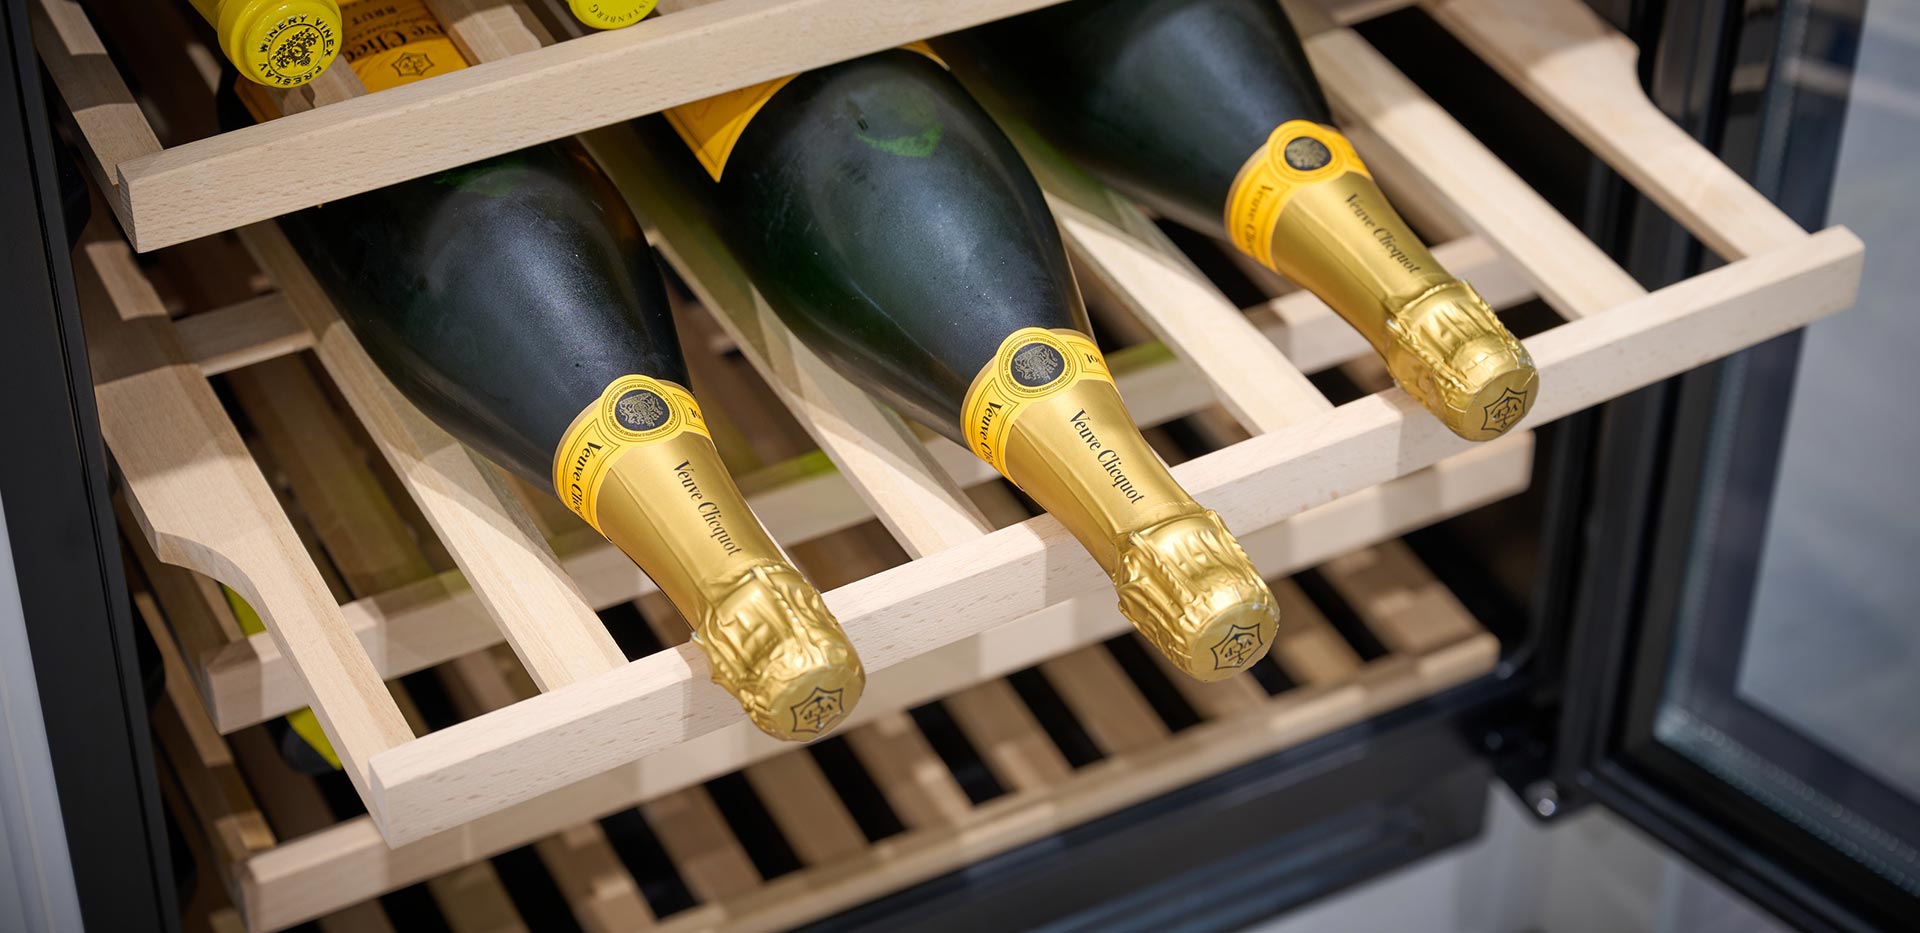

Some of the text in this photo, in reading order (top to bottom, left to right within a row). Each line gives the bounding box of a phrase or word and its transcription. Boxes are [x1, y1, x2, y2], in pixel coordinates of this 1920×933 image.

[258, 15, 308, 53] WINERY
[315, 17, 335, 57] VINEX
[258, 63, 322, 86] PRESLAV
[1345, 193, 1421, 274] Veuve Clicquot
[980, 401, 1003, 441] Veuve
[571, 440, 604, 482] Veuve
[1070, 408, 1102, 452] Veuve
[1097, 449, 1145, 505] Clicquot
[672, 458, 743, 556] Veuve Clicquot
